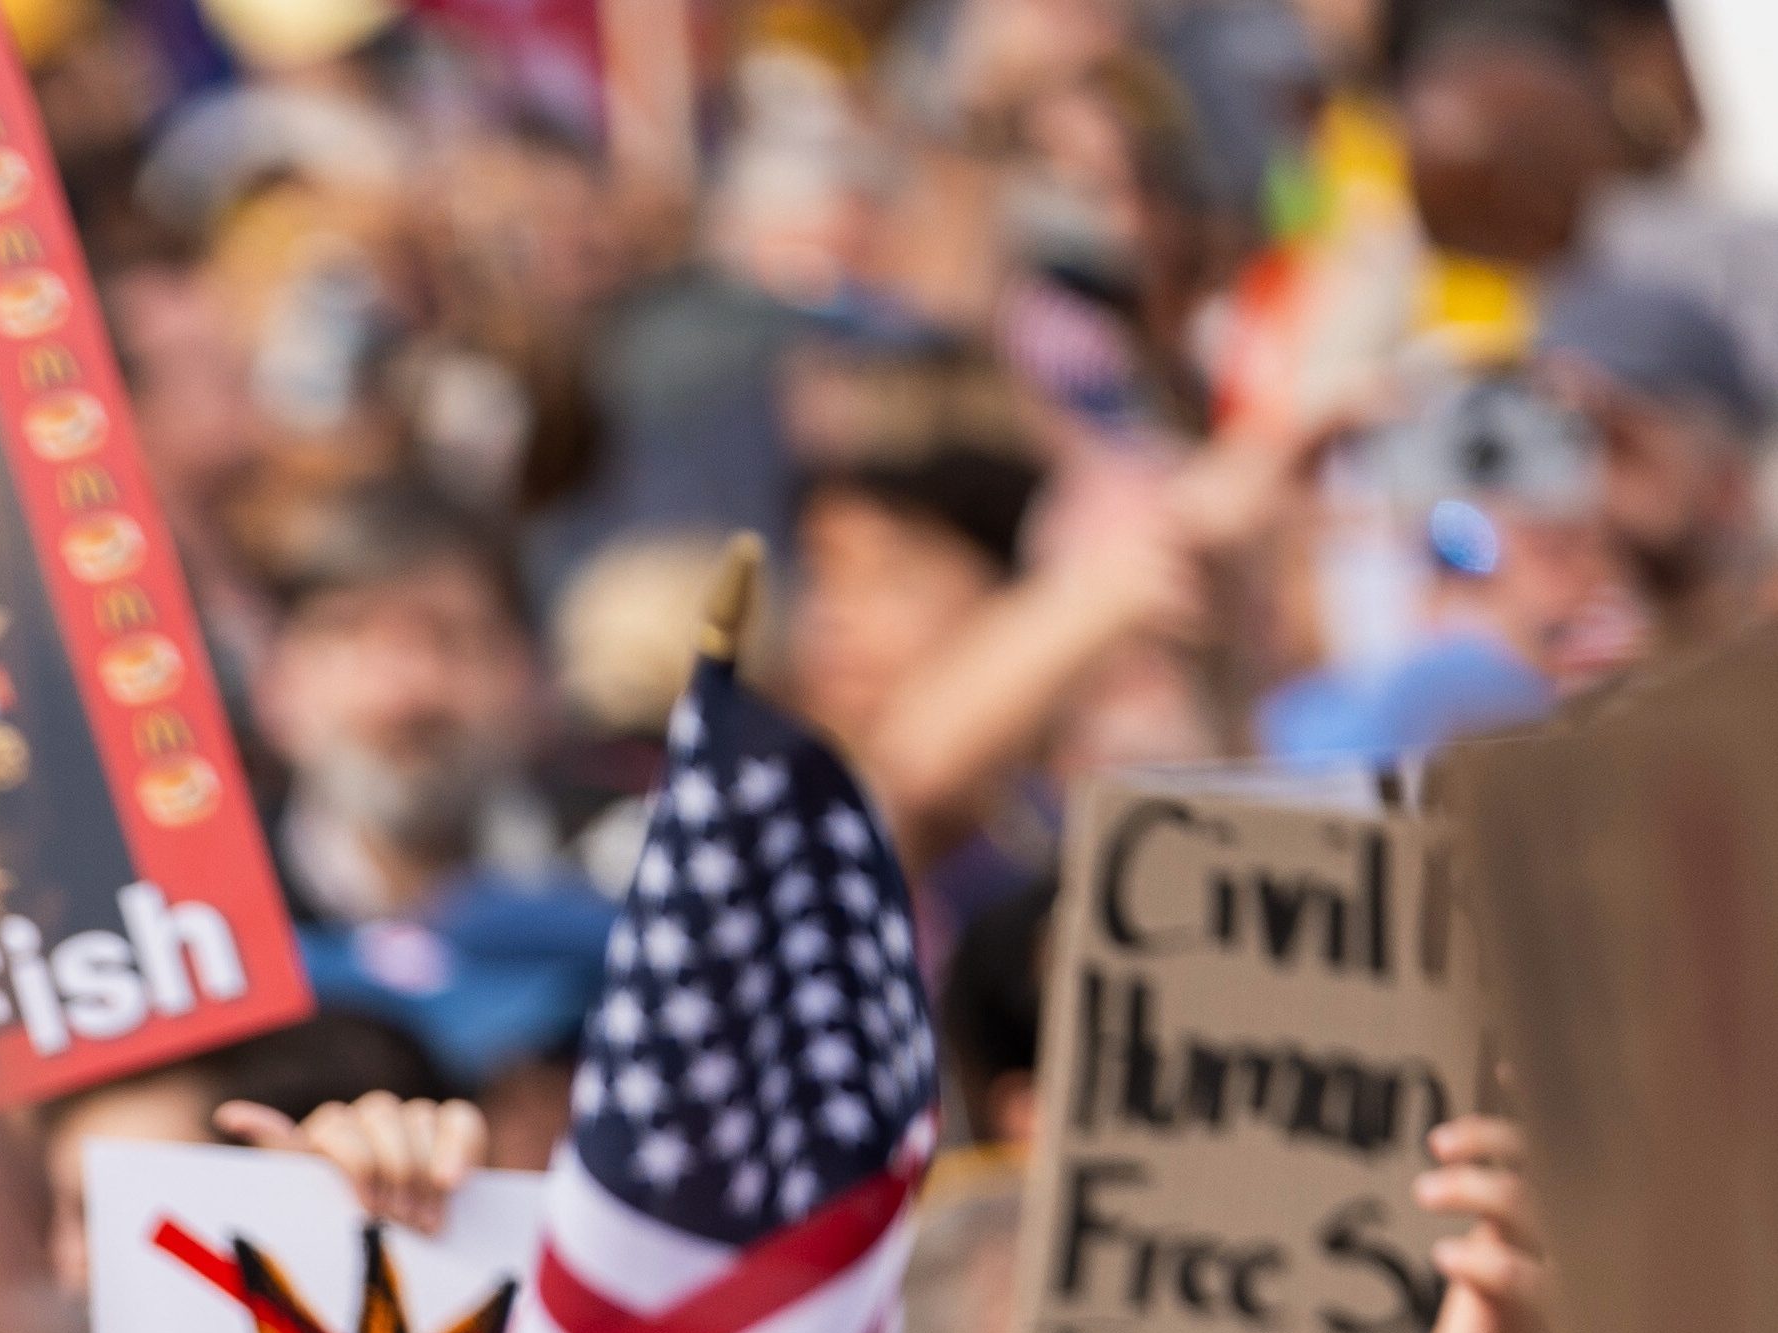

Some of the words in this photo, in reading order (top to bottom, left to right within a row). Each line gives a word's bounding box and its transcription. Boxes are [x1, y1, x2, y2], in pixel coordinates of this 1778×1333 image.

[1096, 796, 1391, 977] Civil
[1071, 966, 1455, 1156] Human
[1053, 1156, 1291, 1324] Free
